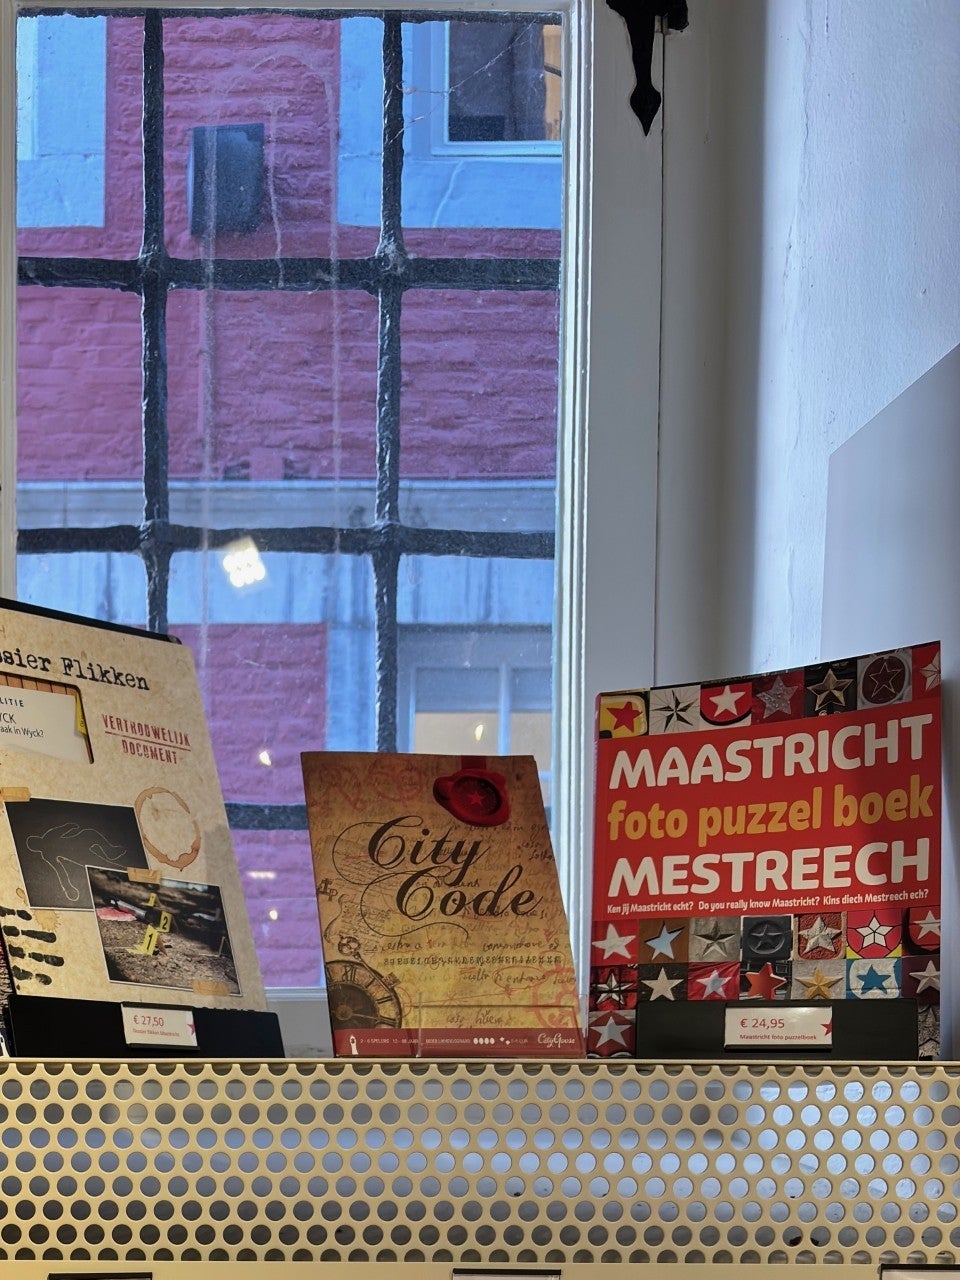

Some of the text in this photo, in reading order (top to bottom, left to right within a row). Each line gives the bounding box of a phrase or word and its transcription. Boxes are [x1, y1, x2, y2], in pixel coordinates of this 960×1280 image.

[60, 656, 151, 691] Flikken
[13, 726, 21, 735] in
[21, 727, 44, 739] Wyck?
[608, 713, 933, 790] MAASTRICHT
[607, 773, 935, 848] foto puzzel boek
[348, 815, 491, 887] City
[607, 836, 931, 898] MESTREECH
[375, 864, 544, 926] Code
[607, 888, 929, 915] Ken jij Maastricht echt? Do you really know Maastricht? Kins diech Mestreech ech?
[161, 916, 169, 930] 2
[146, 933, 154, 950] 1
[133, 1014, 165, 1027] € 27,50
[740, 1018, 785, 1029] € 24,95
